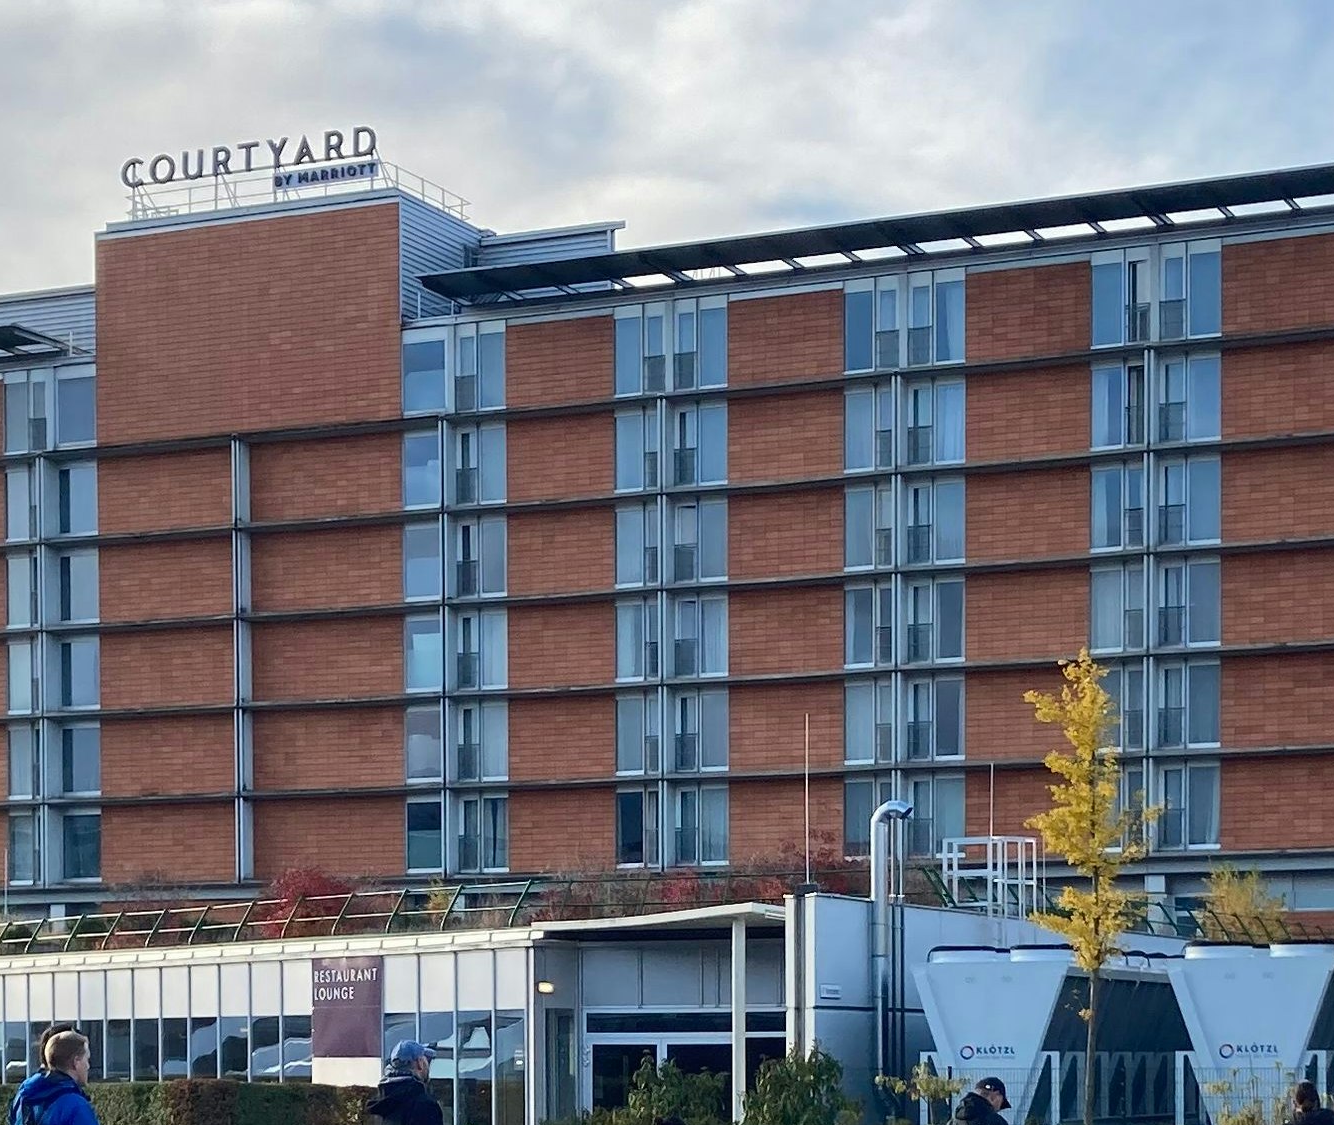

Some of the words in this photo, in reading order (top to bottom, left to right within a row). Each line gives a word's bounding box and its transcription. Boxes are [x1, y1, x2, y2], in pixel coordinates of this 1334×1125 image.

[121, 126, 377, 188] COURTYARD
[274, 174, 292, 187] BY
[298, 163, 376, 183] MARRIOTT
[314, 967, 378, 983] RESTAURANT
[314, 986, 355, 1001] LOUNGE
